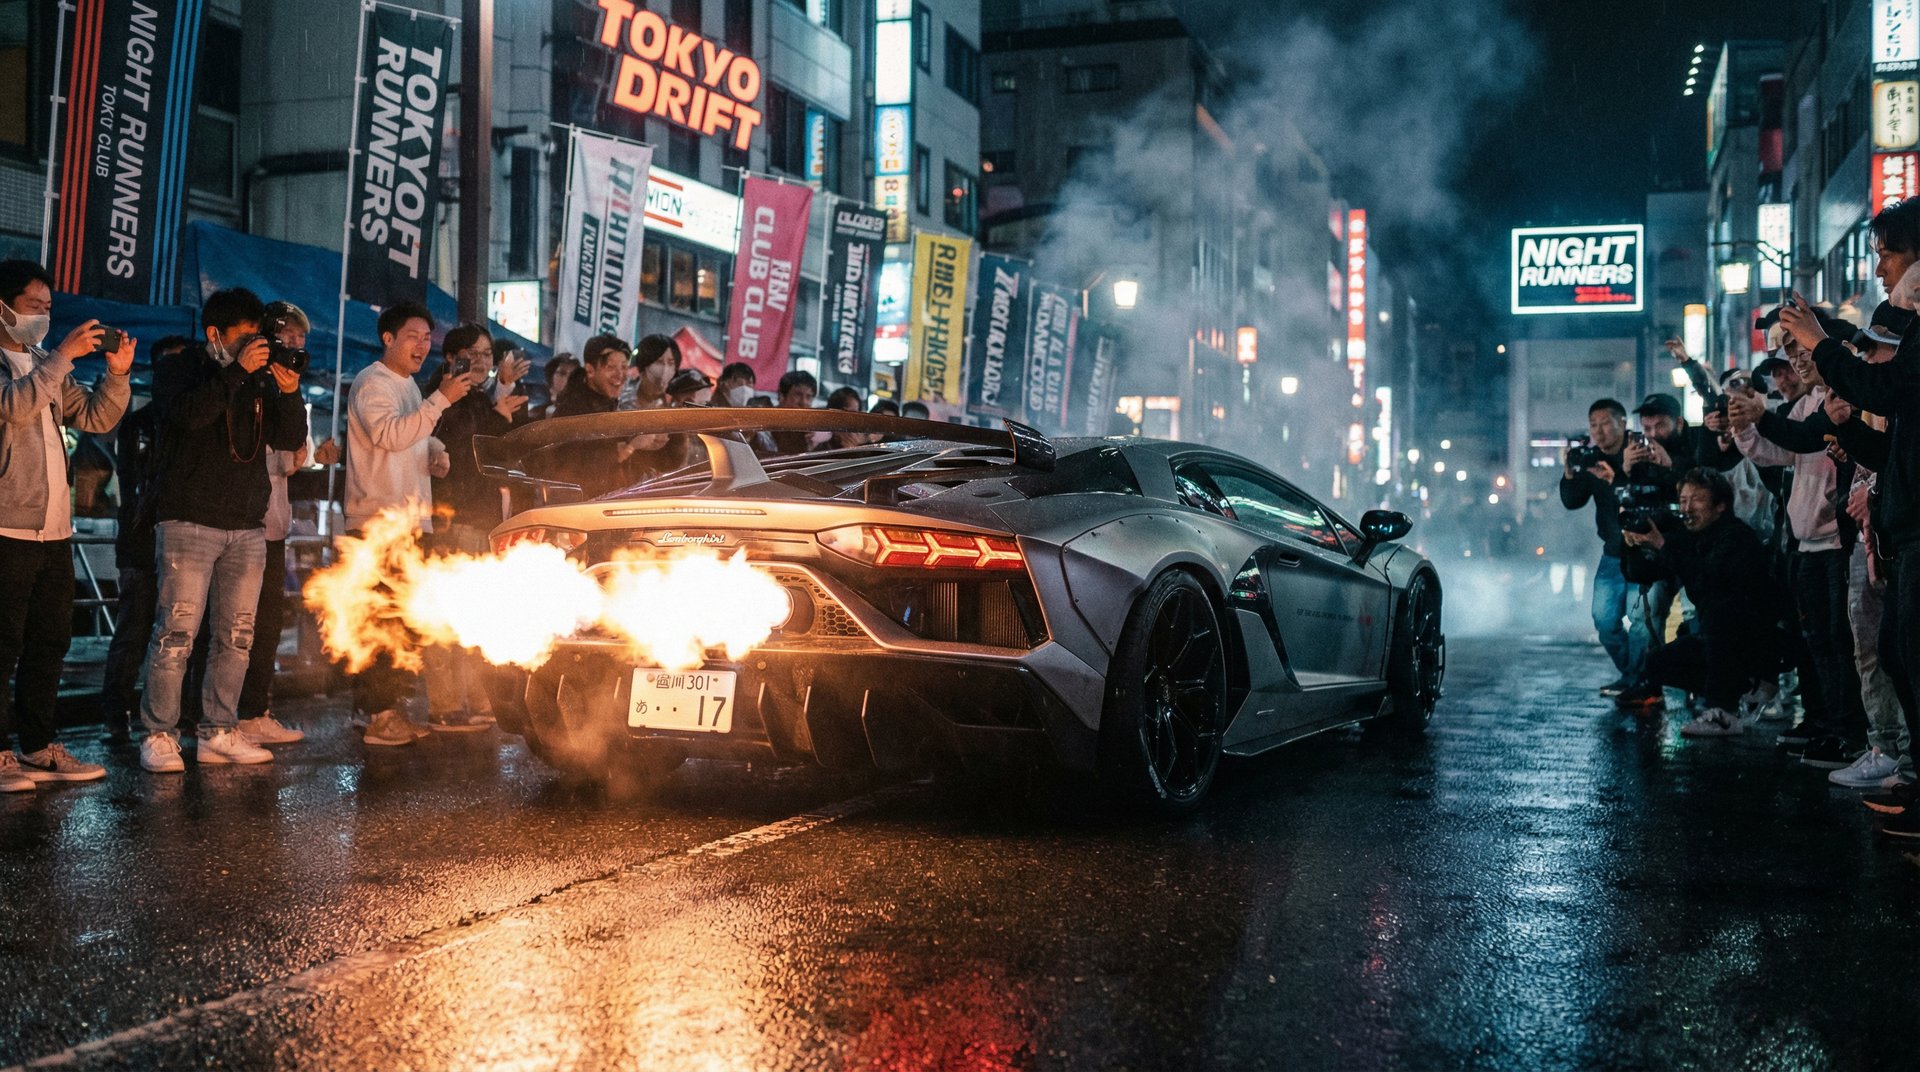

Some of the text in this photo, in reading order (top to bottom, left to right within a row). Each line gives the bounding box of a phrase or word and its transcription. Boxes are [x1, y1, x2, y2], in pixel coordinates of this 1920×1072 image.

[599, 0, 761, 103] TOKYO
[106, 0, 159, 280] NIGHT RUNNERS
[359, 37, 407, 246] RUNNERS
[613, 54, 762, 152] DRIFT
[95, 131, 112, 178] CLUB
[387, 46, 443, 280] TOKYOFT
[737, 204, 776, 361] CLUB CLUB
[1519, 263, 1635, 287] RUNNERS
[1520, 235, 1636, 268] NIGHT
[697, 694, 727, 728] 17
